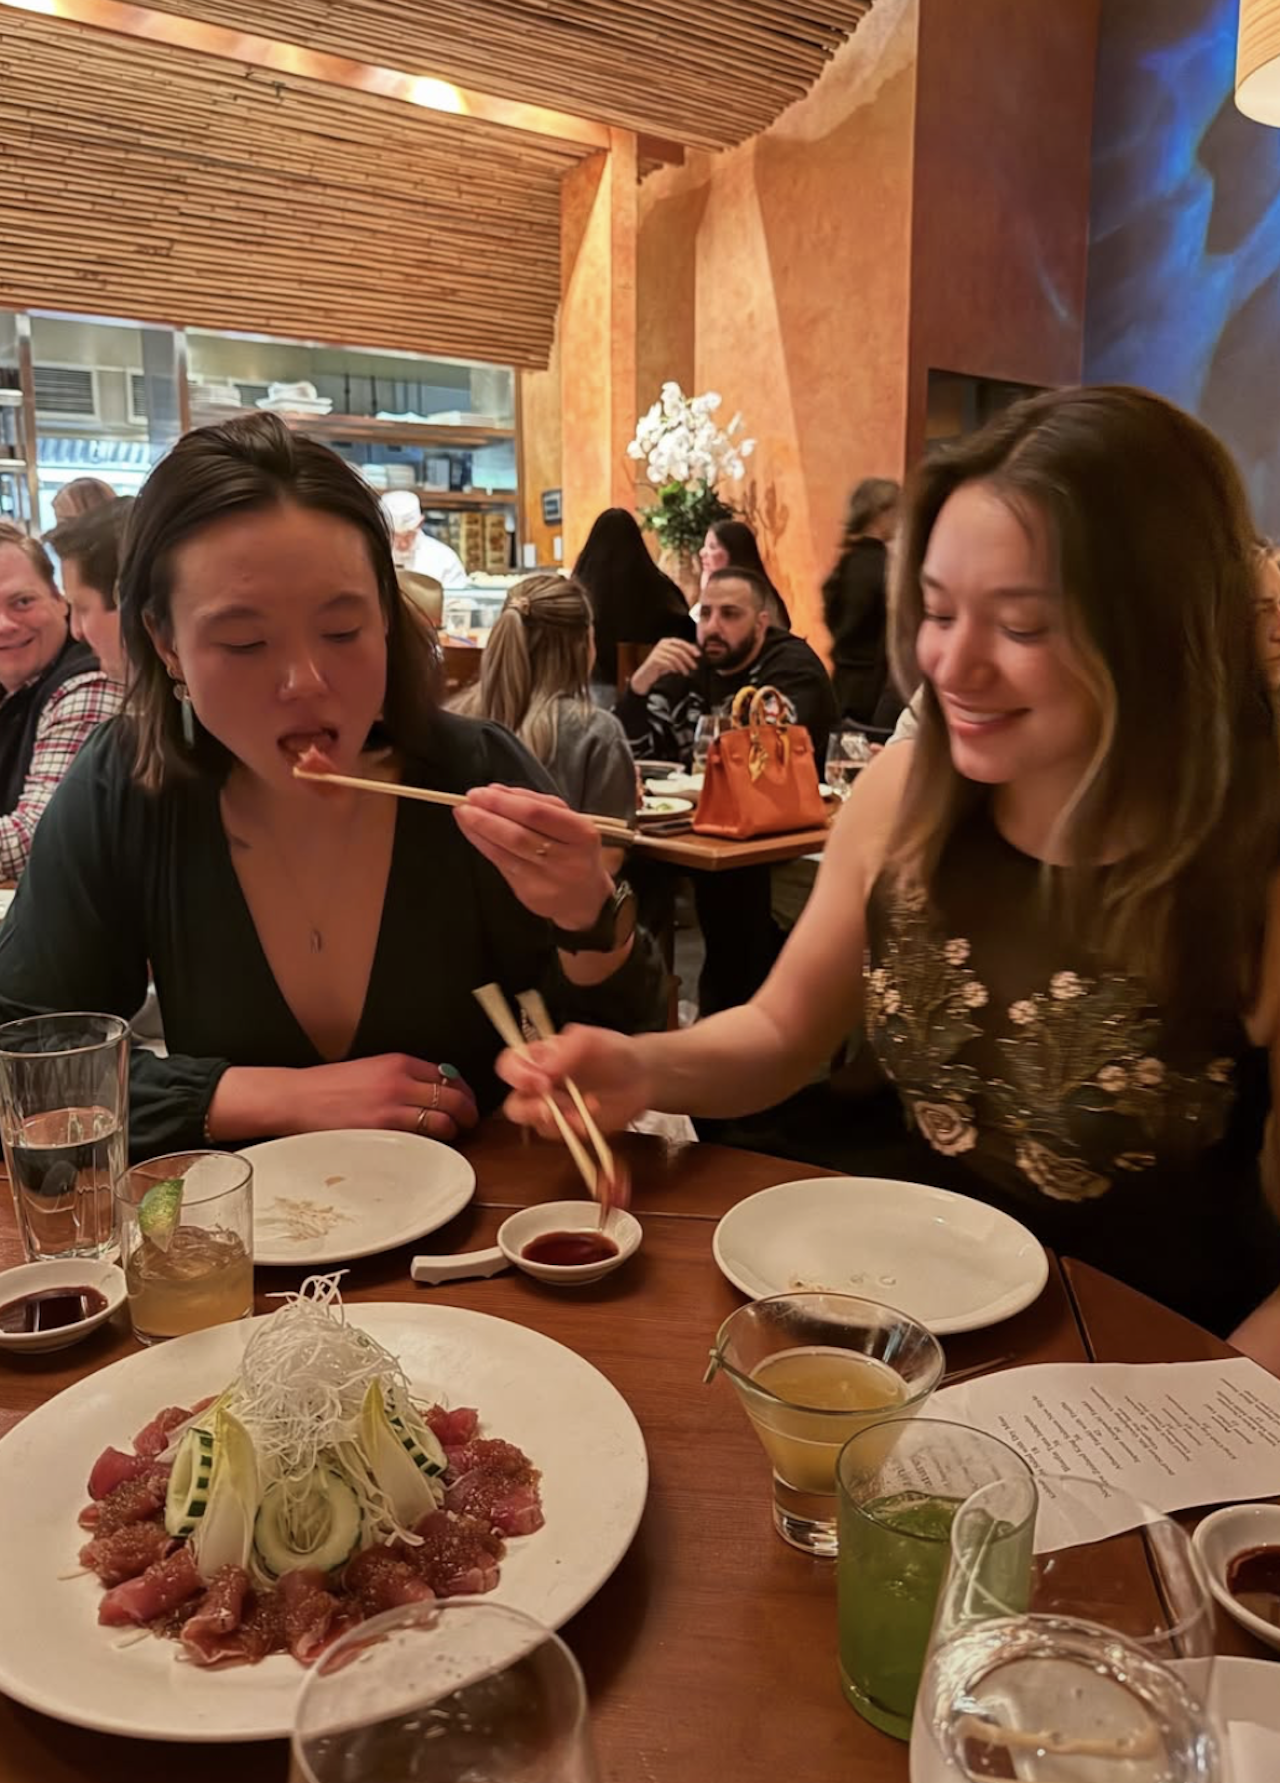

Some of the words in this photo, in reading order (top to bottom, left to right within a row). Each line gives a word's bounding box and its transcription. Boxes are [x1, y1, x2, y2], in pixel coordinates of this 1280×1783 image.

[1032, 1395, 1045, 1408] Style
[1043, 1407, 1054, 1421] New
[998, 1415, 1011, 1431] Miso
[1053, 1419, 1070, 1440] Salmon
[1075, 1417, 1087, 1430] with
[1008, 1430, 1020, 1442] Dry
[1016, 1440, 1029, 1454] with
[1040, 1437, 1054, 1452] Tuna
[1068, 1439, 1080, 1454] King
[1024, 1453, 1040, 1469] Salad
[1078, 1452, 1101, 1475] Zealand
